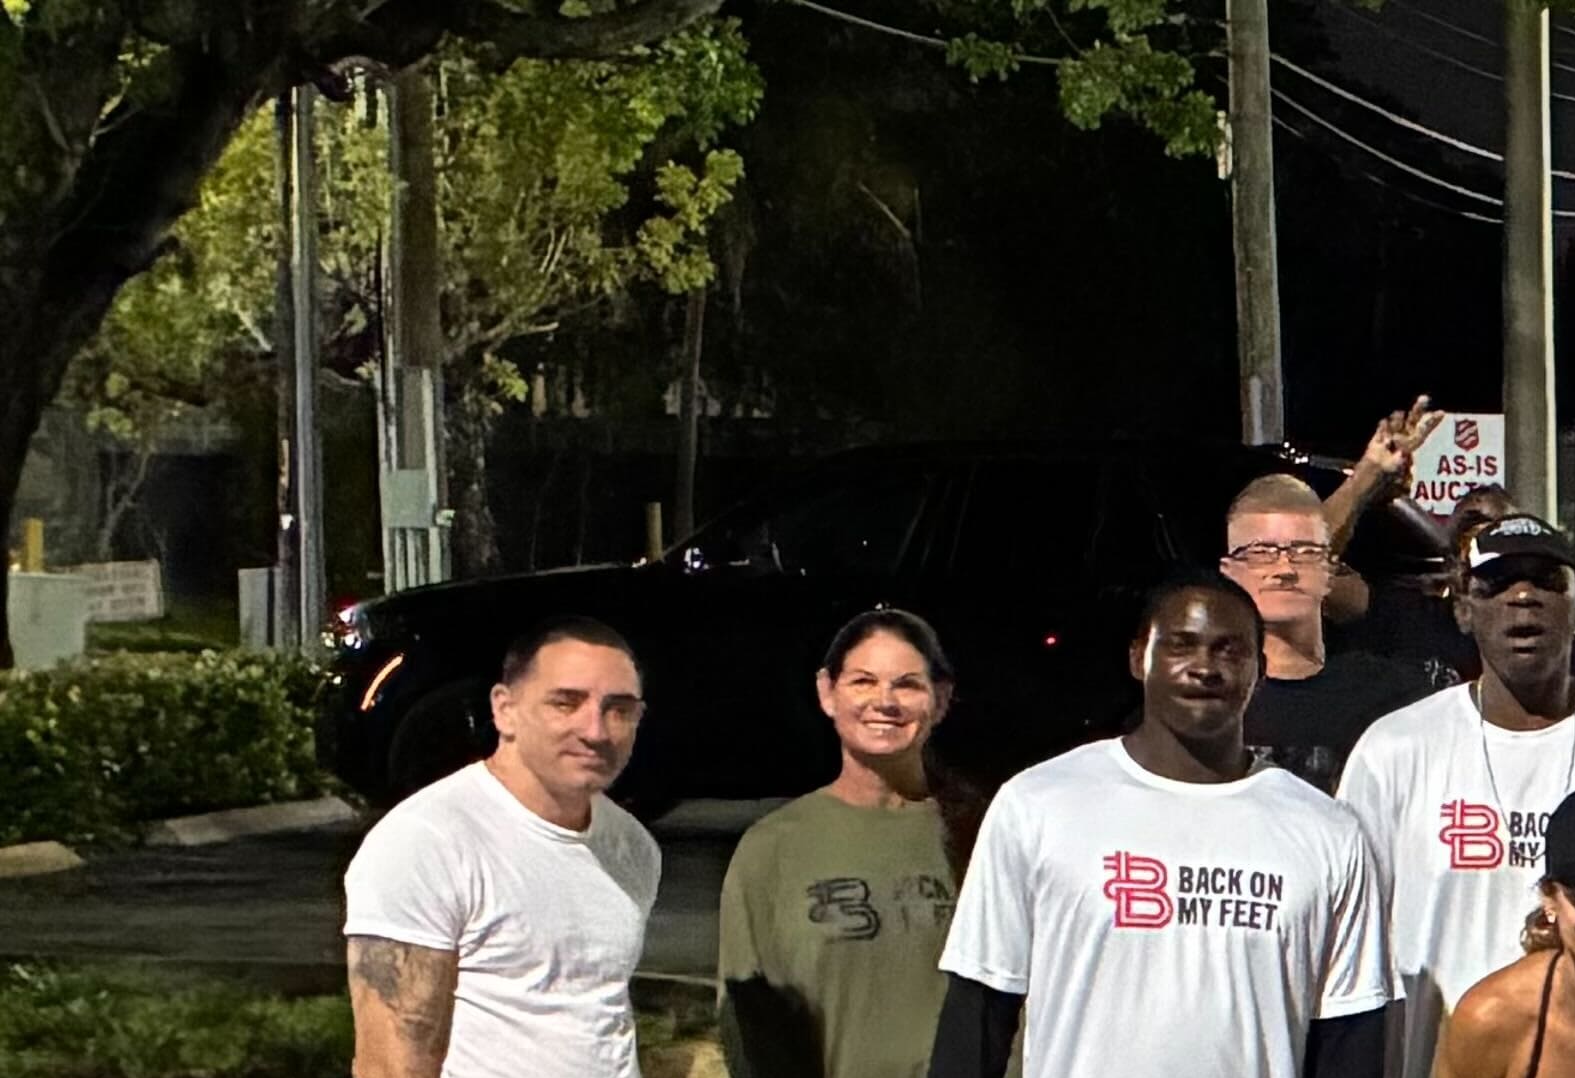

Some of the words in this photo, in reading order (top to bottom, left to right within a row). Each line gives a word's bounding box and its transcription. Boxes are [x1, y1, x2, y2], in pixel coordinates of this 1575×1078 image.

[1437, 454, 1498, 476] AS-IS
[1510, 811, 1552, 838] BAC
[1508, 839, 1541, 868] MY
[1178, 865, 1245, 896] BACK
[1250, 871, 1283, 902] ON
[1177, 897, 1213, 927] MY
